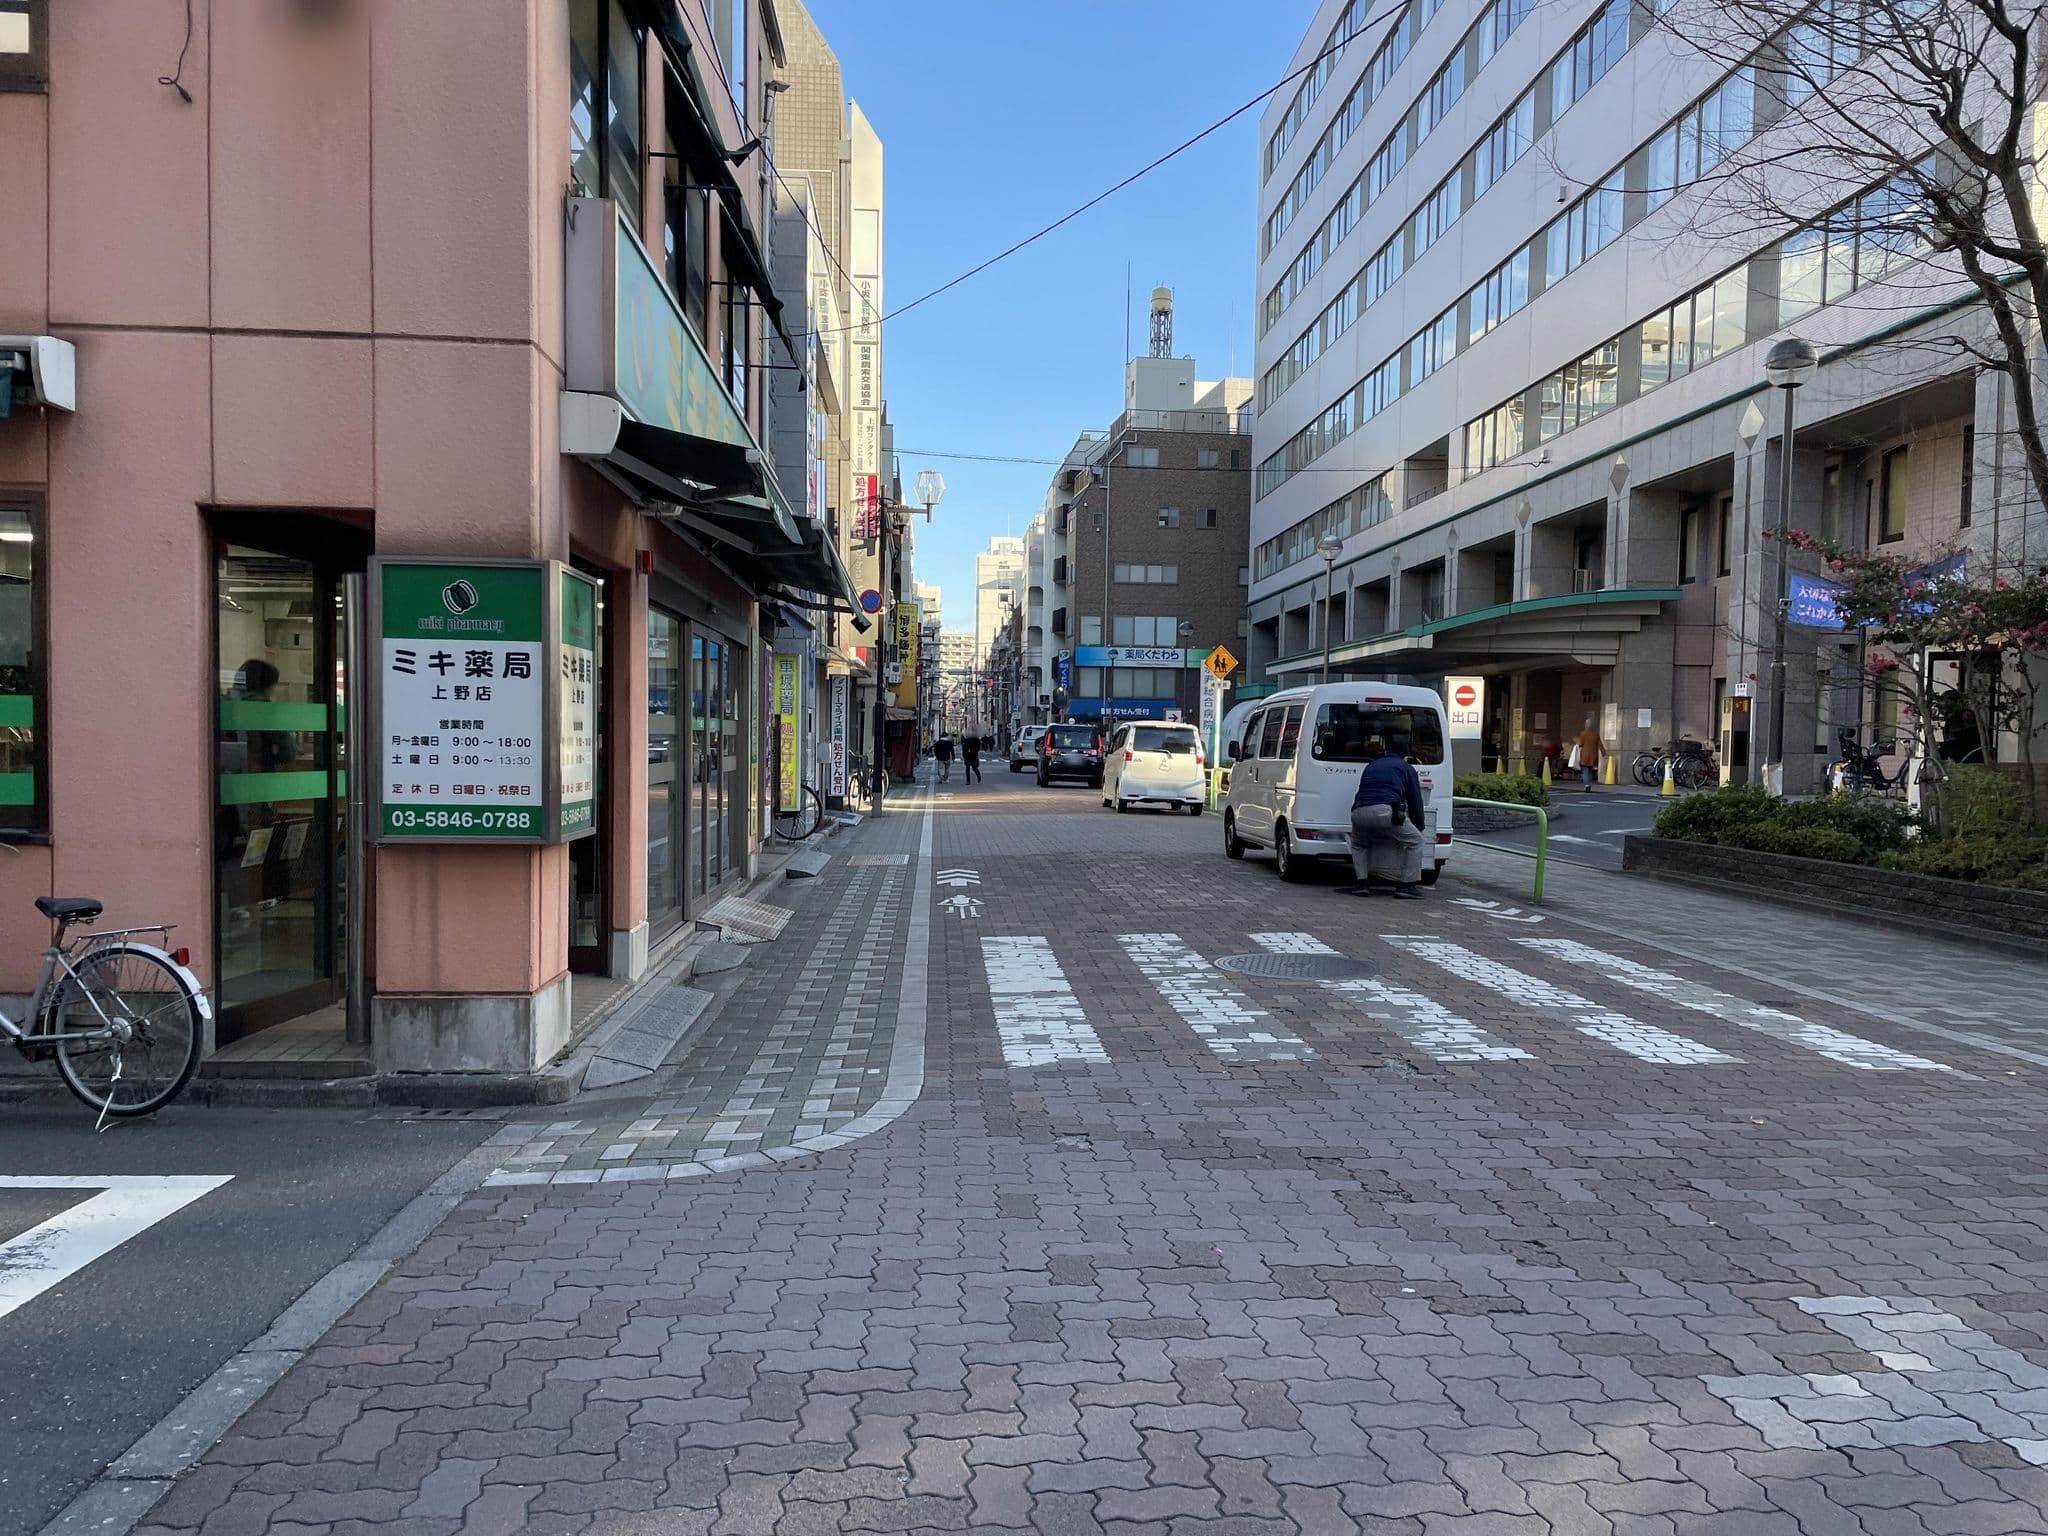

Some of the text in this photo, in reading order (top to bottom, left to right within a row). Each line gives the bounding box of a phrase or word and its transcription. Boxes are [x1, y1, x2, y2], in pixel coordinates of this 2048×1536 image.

[855, 477, 865, 537] 処方せん受付
[418, 617, 505, 634] miki pharmacy
[1124, 649, 1180, 660] 薬局くだわら
[392, 650, 532, 679] ミキ薬局
[431, 685, 492, 701] 上野店
[438, 719, 484, 730] 営業時間
[1452, 711, 1479, 724] 出口
[391, 754, 440, 766] 土曜日
[833, 743, 843, 794] 処方せん受付
[391, 783, 531, 796] 定休日 日曜日・祝祭日
[391, 810, 531, 828] 03-5846-0788
